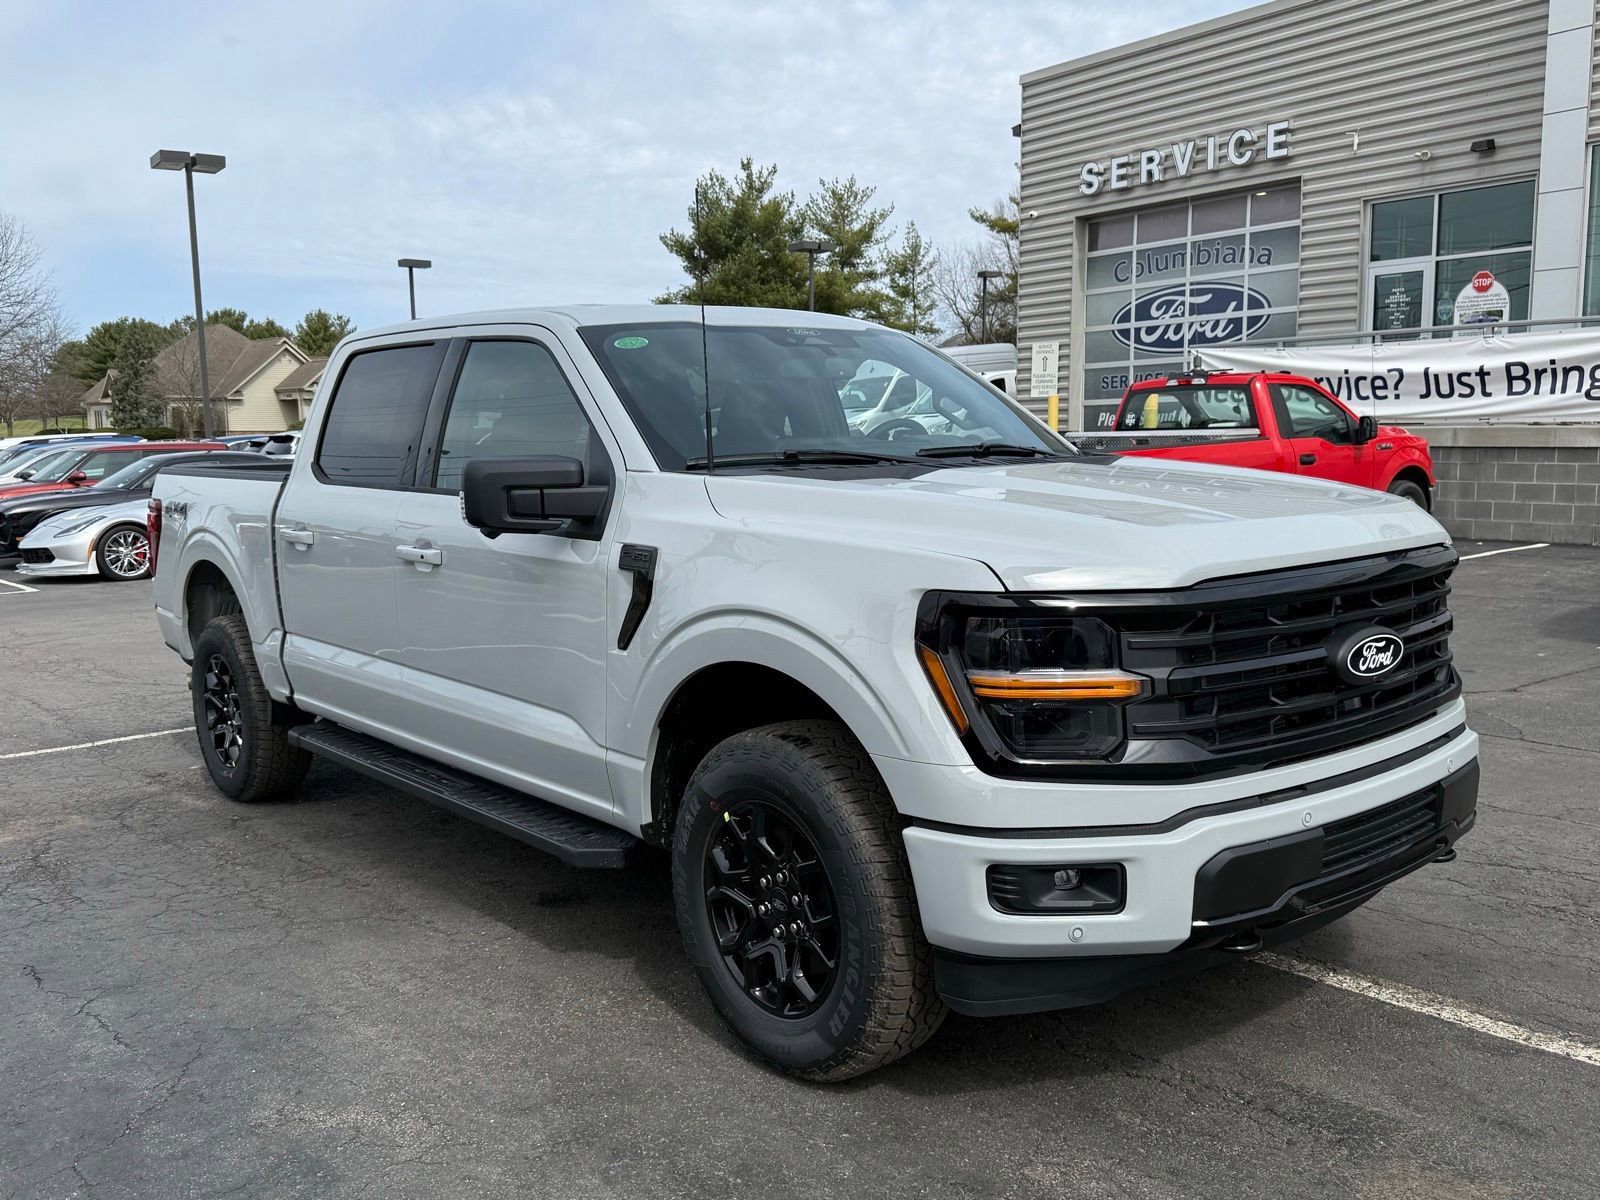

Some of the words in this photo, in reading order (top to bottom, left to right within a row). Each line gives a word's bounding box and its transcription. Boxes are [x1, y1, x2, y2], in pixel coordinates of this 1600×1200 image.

[1080, 120, 1293, 195] SERVICE
[1114, 242, 1273, 282] Columbiana
[1474, 278, 1492, 287] STOP
[1140, 293, 1237, 343] Ford
[1419, 365, 1493, 399] Just
[1505, 359, 1600, 400] Bring
[1359, 641, 1394, 671] Ford
